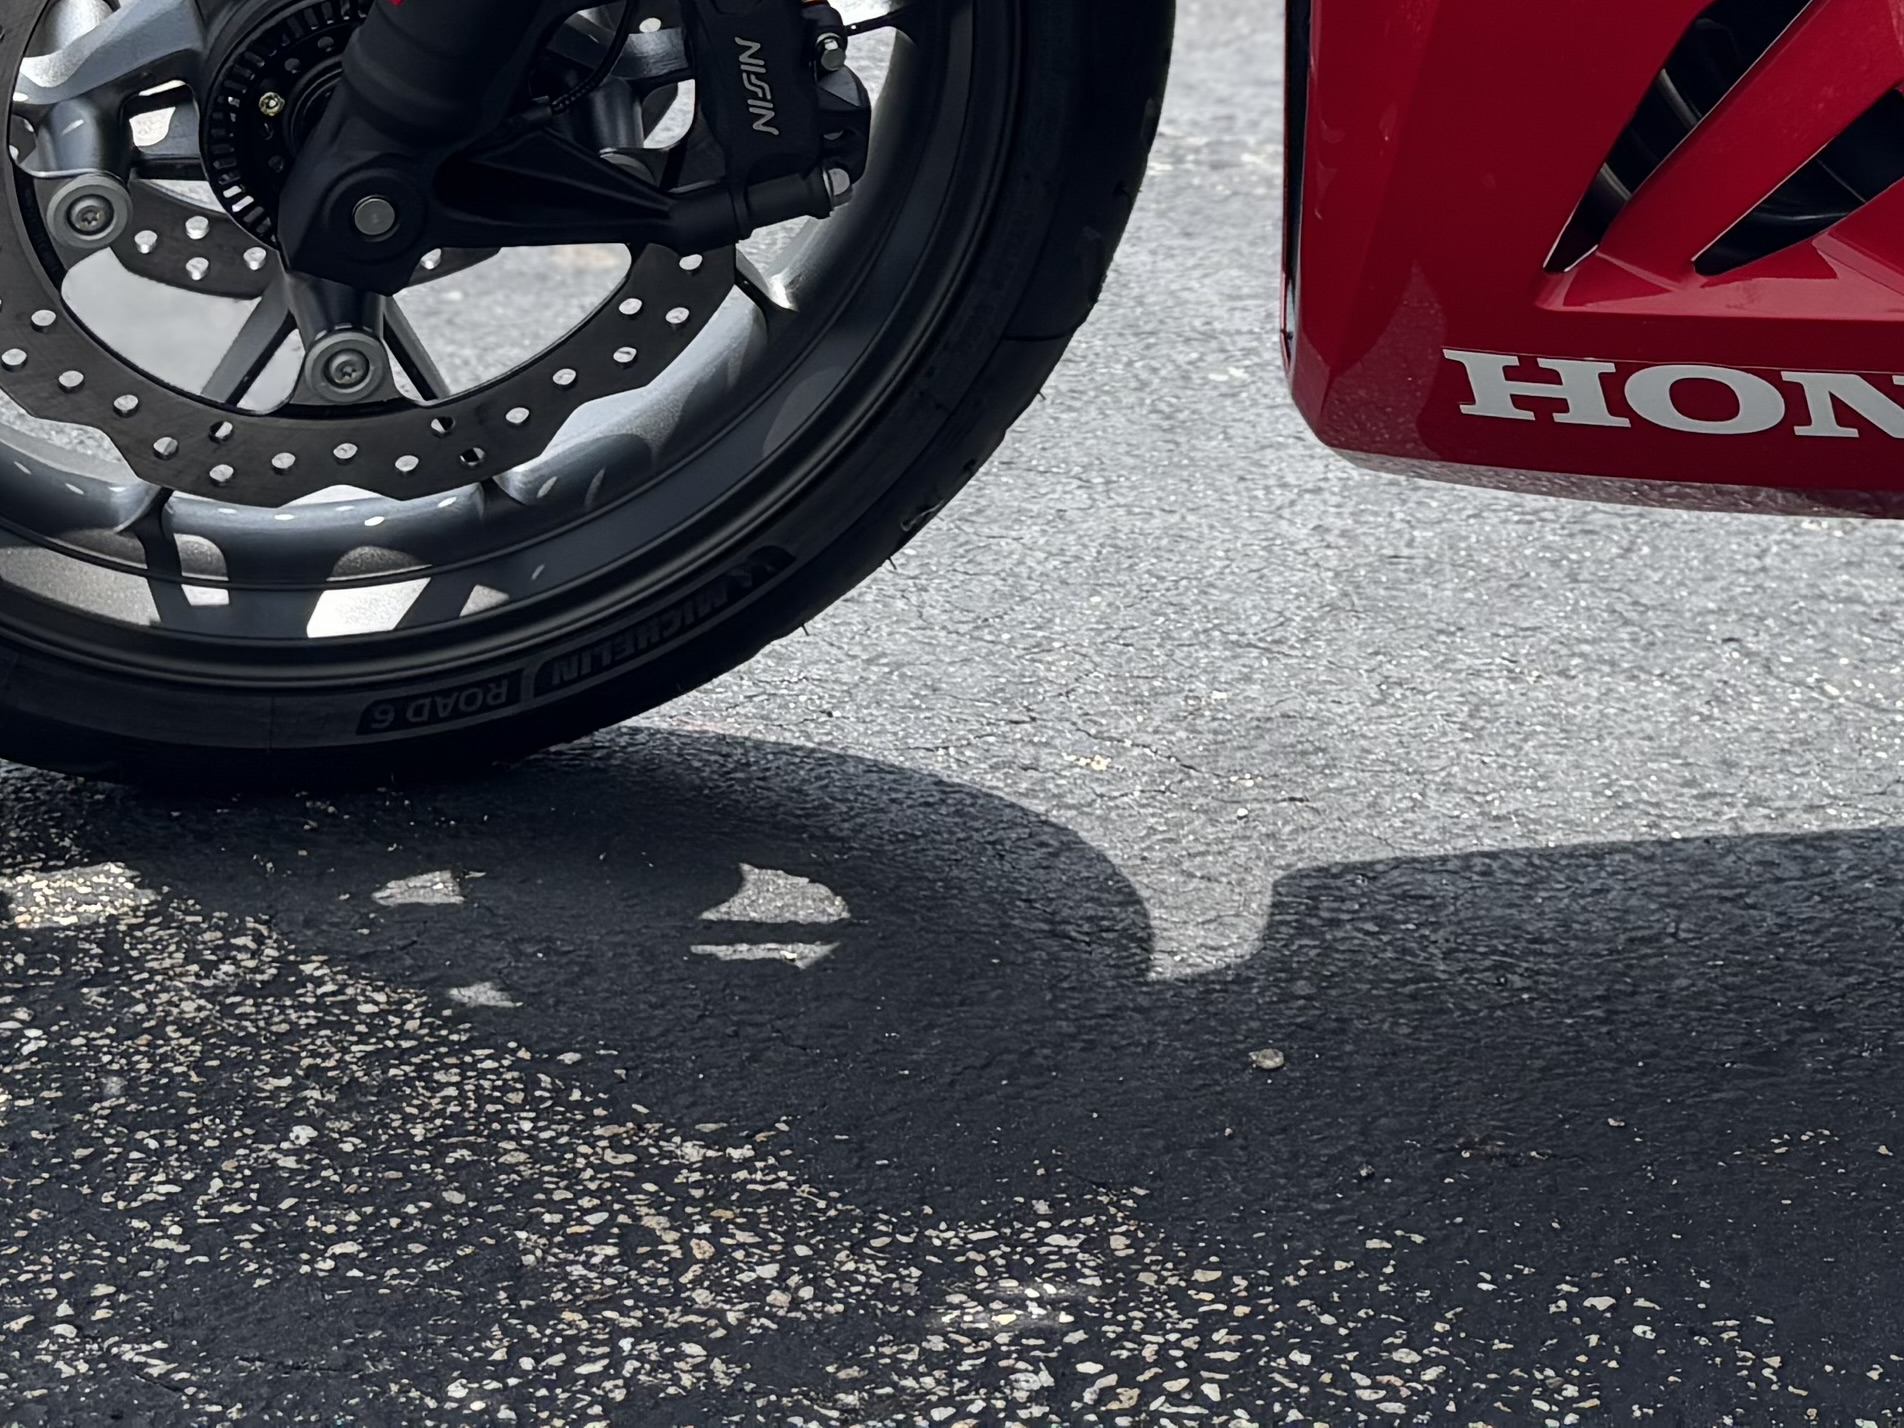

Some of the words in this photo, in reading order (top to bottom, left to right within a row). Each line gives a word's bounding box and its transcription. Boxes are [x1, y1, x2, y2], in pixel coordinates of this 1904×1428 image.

[735, 36, 780, 136] NISSIN
[551, 580, 729, 687] MICHELIN
[370, 703, 396, 729] 6
[405, 678, 509, 723] ROAD
